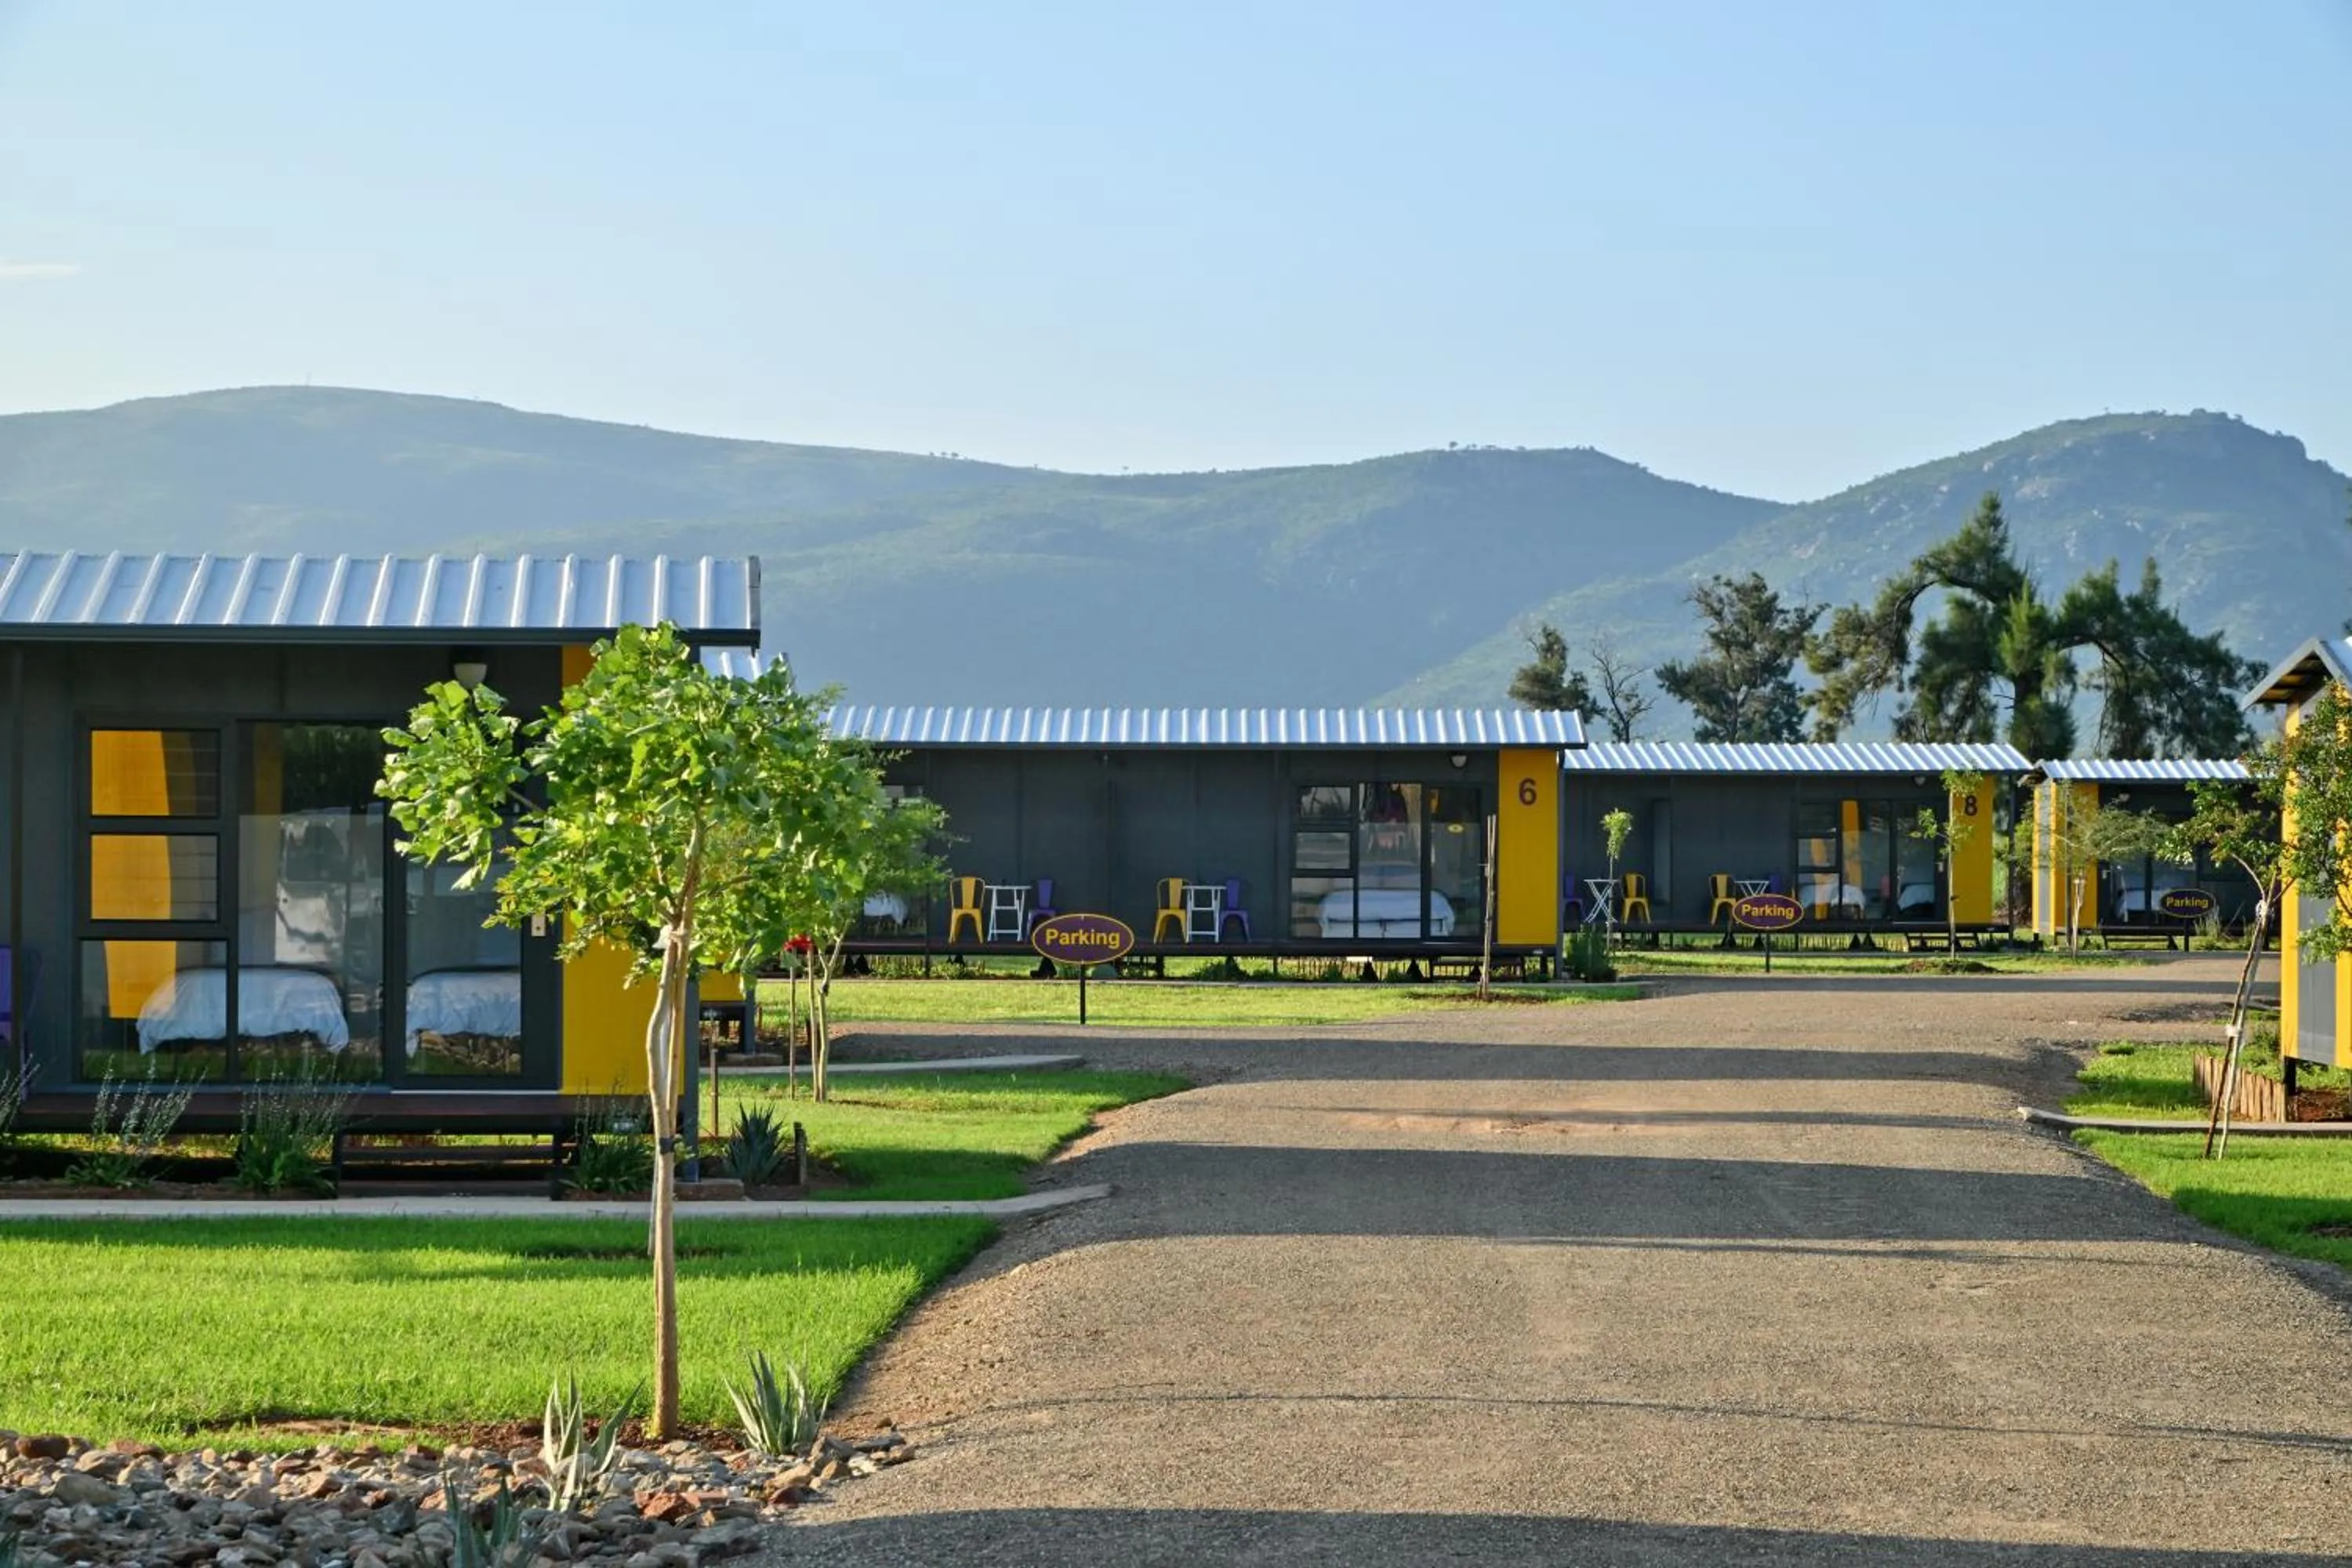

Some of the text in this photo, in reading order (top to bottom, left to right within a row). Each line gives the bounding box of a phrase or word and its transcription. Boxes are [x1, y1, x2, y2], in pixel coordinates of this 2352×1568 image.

[1519, 778, 1537, 806] 6
[1965, 795, 1977, 816] 8
[1742, 904, 1794, 920] Parking
[2166, 897, 2209, 909] Parking
[1045, 928, 1120, 949] Parking
